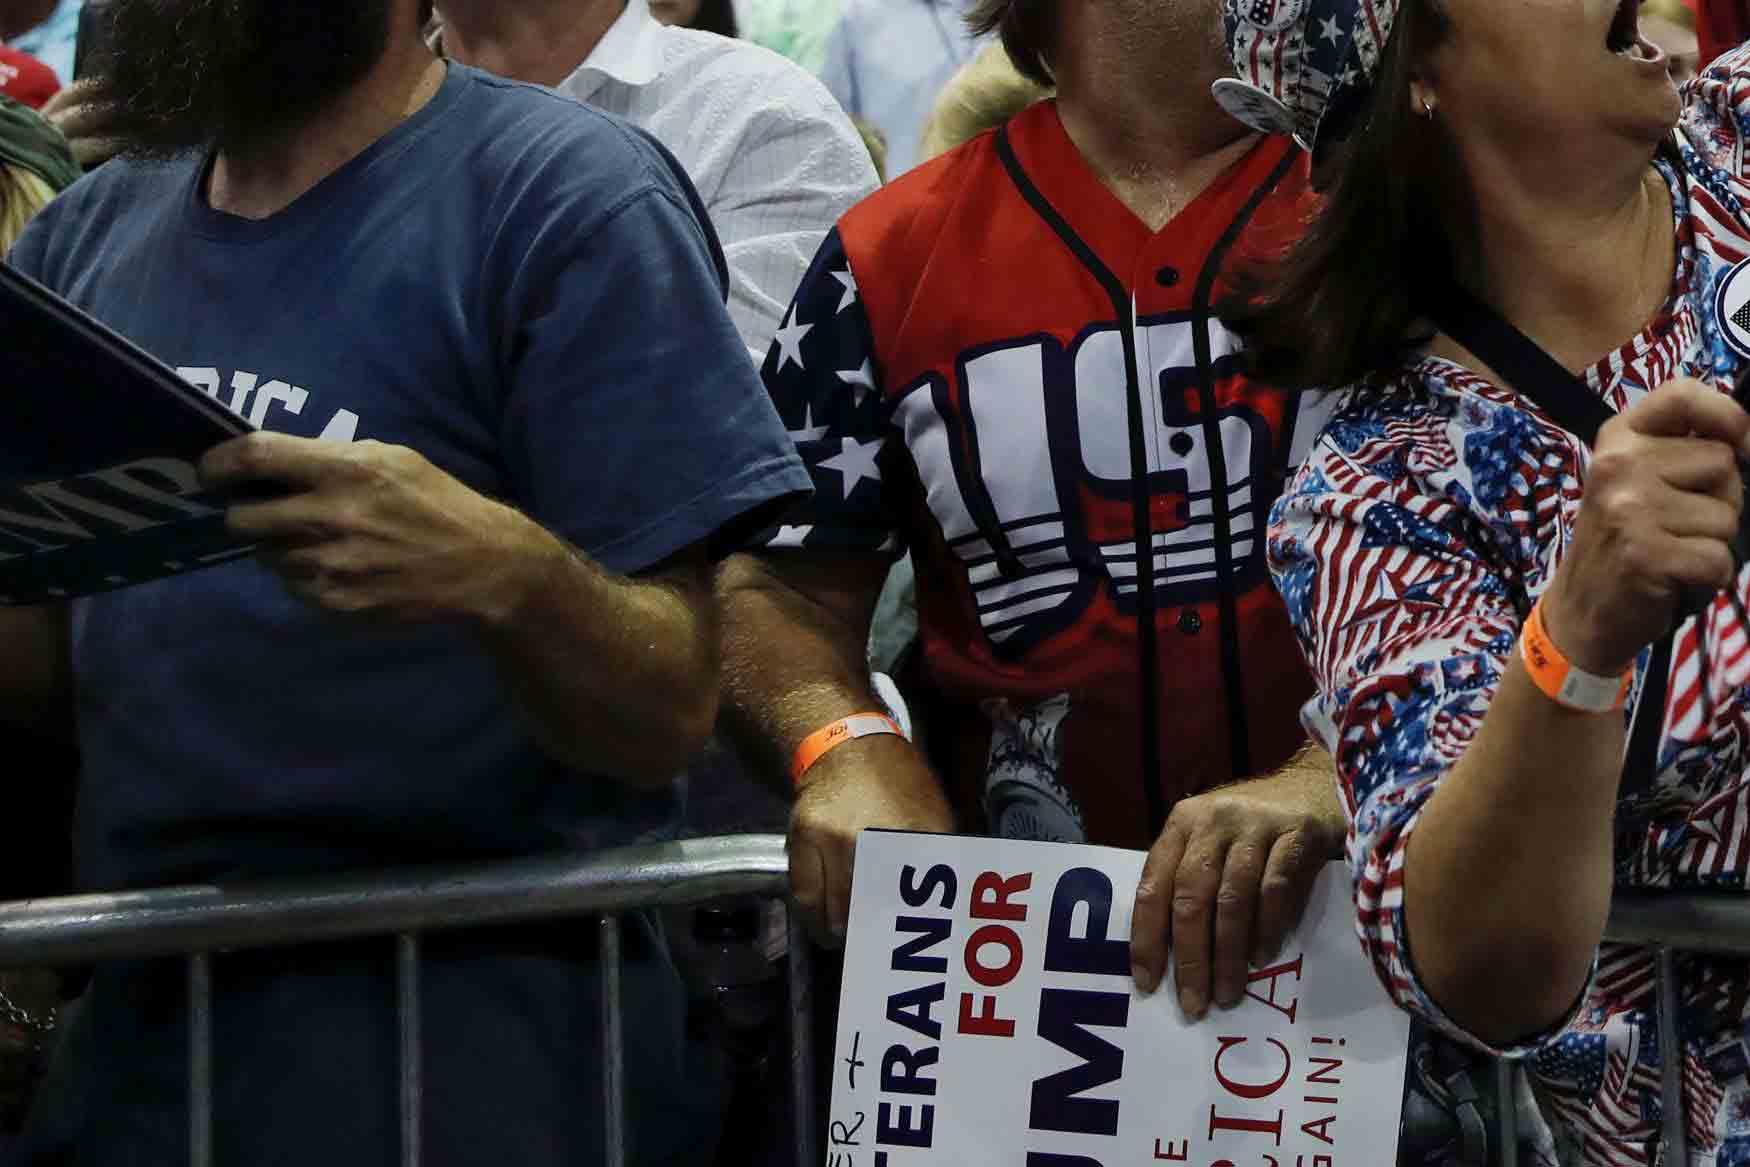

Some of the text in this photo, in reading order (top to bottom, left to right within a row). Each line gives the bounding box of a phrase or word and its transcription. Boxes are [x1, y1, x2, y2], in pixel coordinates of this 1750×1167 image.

[893, 316, 1322, 644] US
[873, 863, 958, 1167] ERANS
[957, 870, 1033, 1038] FOR
[1025, 866, 1132, 1167] MP
[1208, 953, 1304, 1167] ICA
